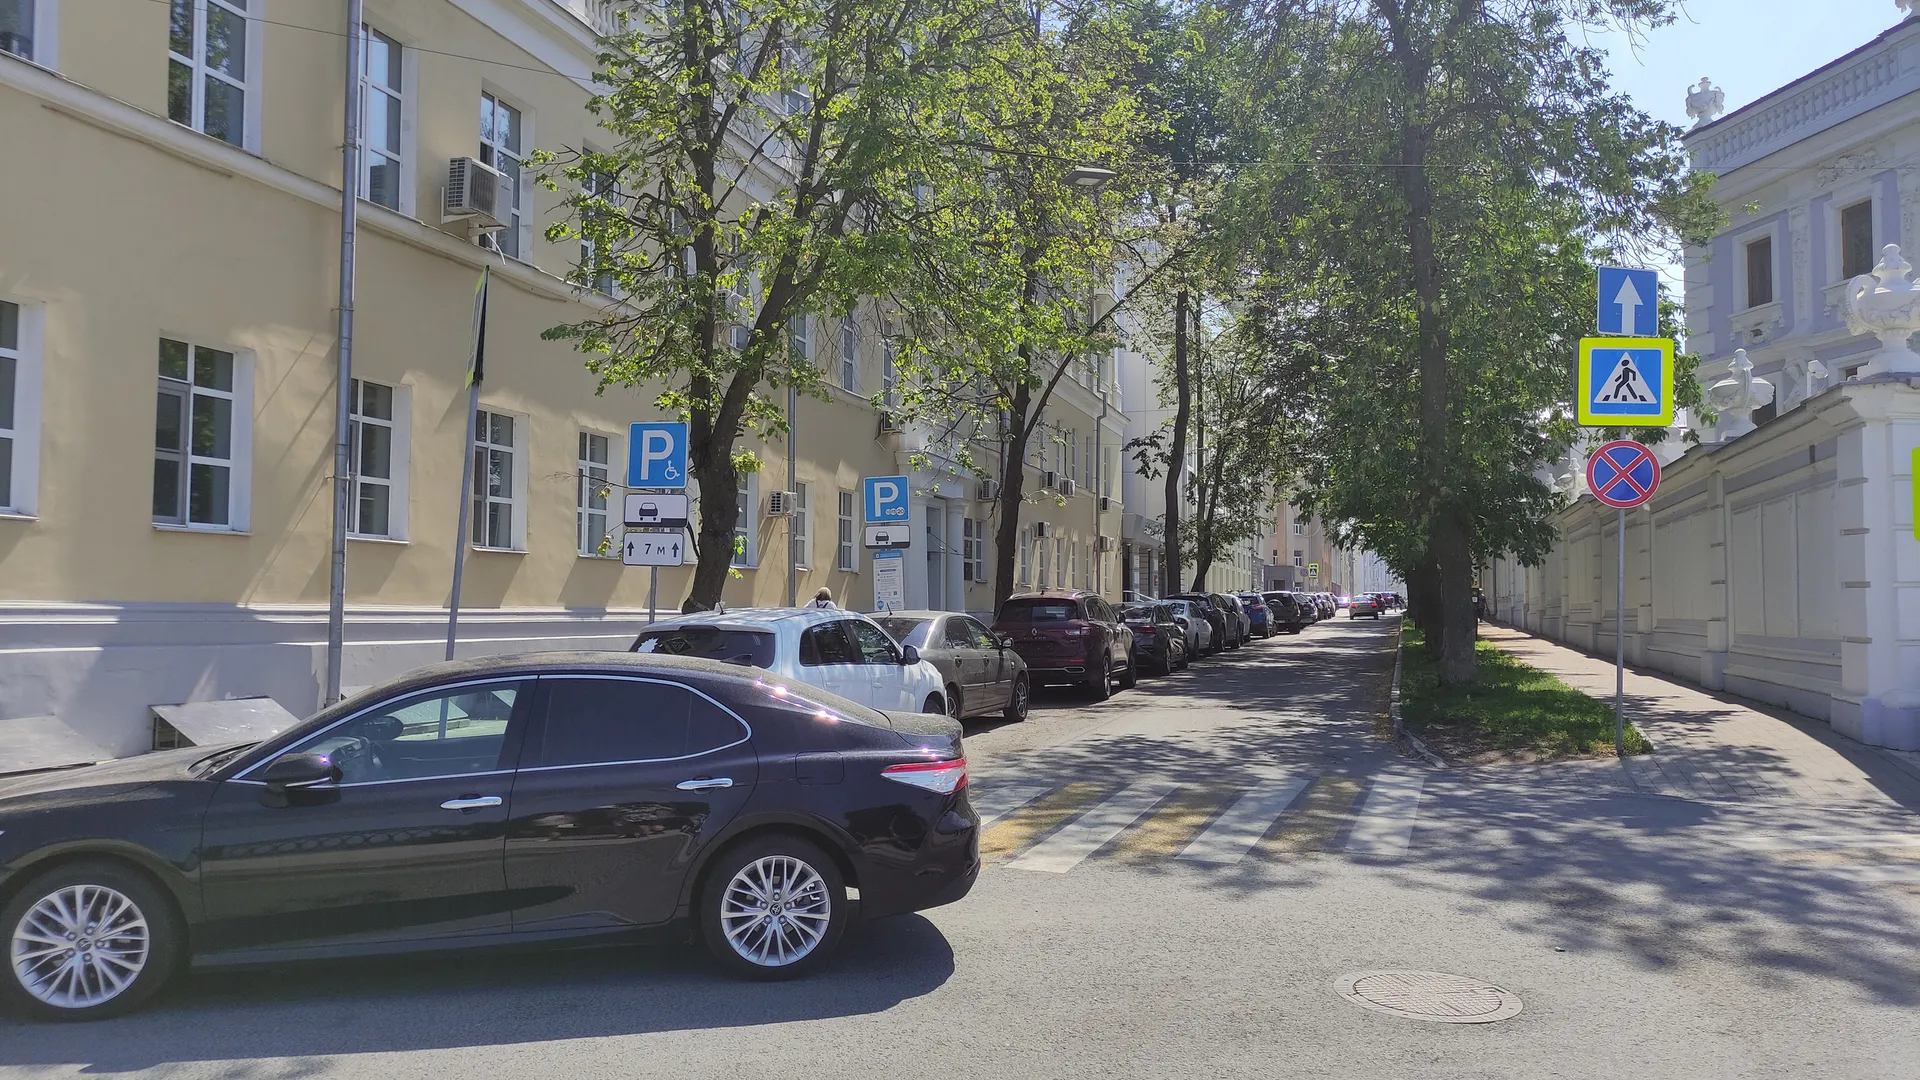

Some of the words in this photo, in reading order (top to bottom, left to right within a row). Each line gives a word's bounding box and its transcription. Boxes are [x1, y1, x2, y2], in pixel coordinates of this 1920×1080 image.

[641, 430, 674, 480] P
[874, 482, 898, 517] P
[644, 543, 652, 555] 7
